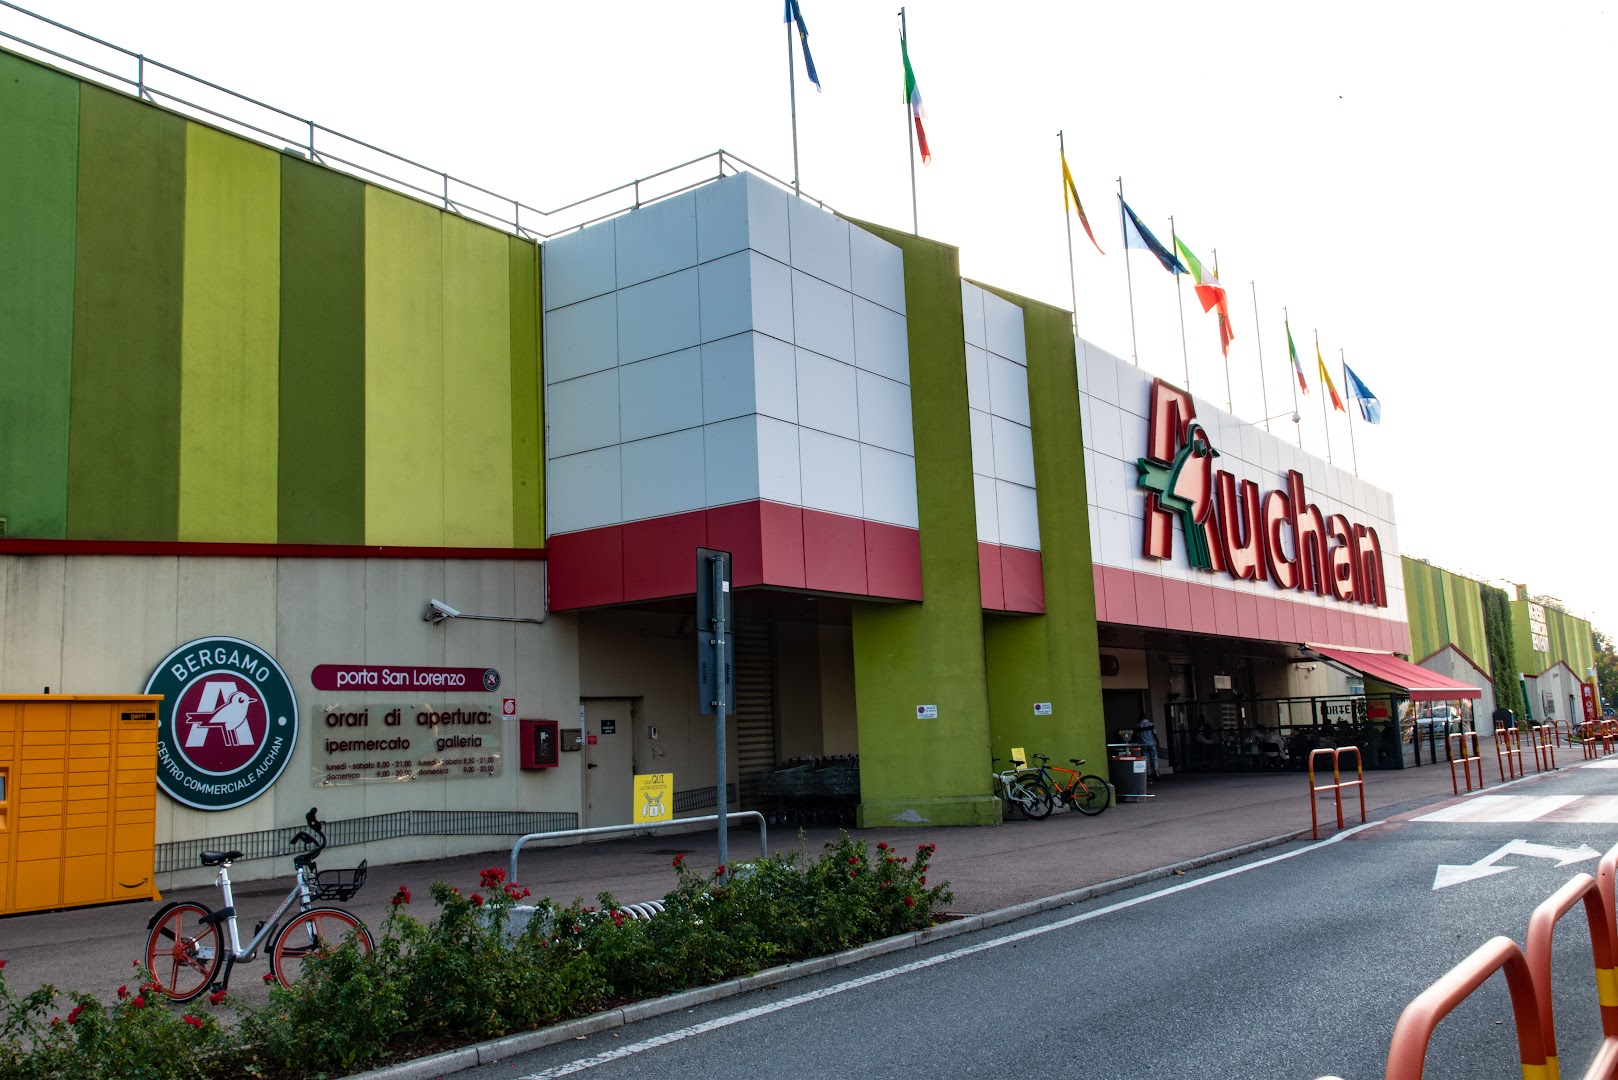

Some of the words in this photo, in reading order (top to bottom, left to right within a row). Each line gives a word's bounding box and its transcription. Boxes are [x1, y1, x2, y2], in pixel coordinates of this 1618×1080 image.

[1139, 377, 1387, 608] Auchan
[170, 647, 270, 682] BERGAMO
[336, 669, 378, 687] porta
[381, 669, 409, 685] San
[413, 670, 466, 686] Lorenzo
[326, 709, 369, 727] orari
[384, 709, 401, 726] di
[416, 708, 492, 728] apertura:
[325, 737, 411, 755] ipermercato
[436, 734, 482, 751] galleria
[157, 741, 185, 781] CENTRO
[183, 773, 257, 795] COMMERCIALE
[256, 736, 284, 778] AUCHAN
[352, 761, 375, 770] sabato
[418, 768, 449, 776] domenica
[326, 772, 361, 780] domenica
[652, 774, 664, 784] QUI
